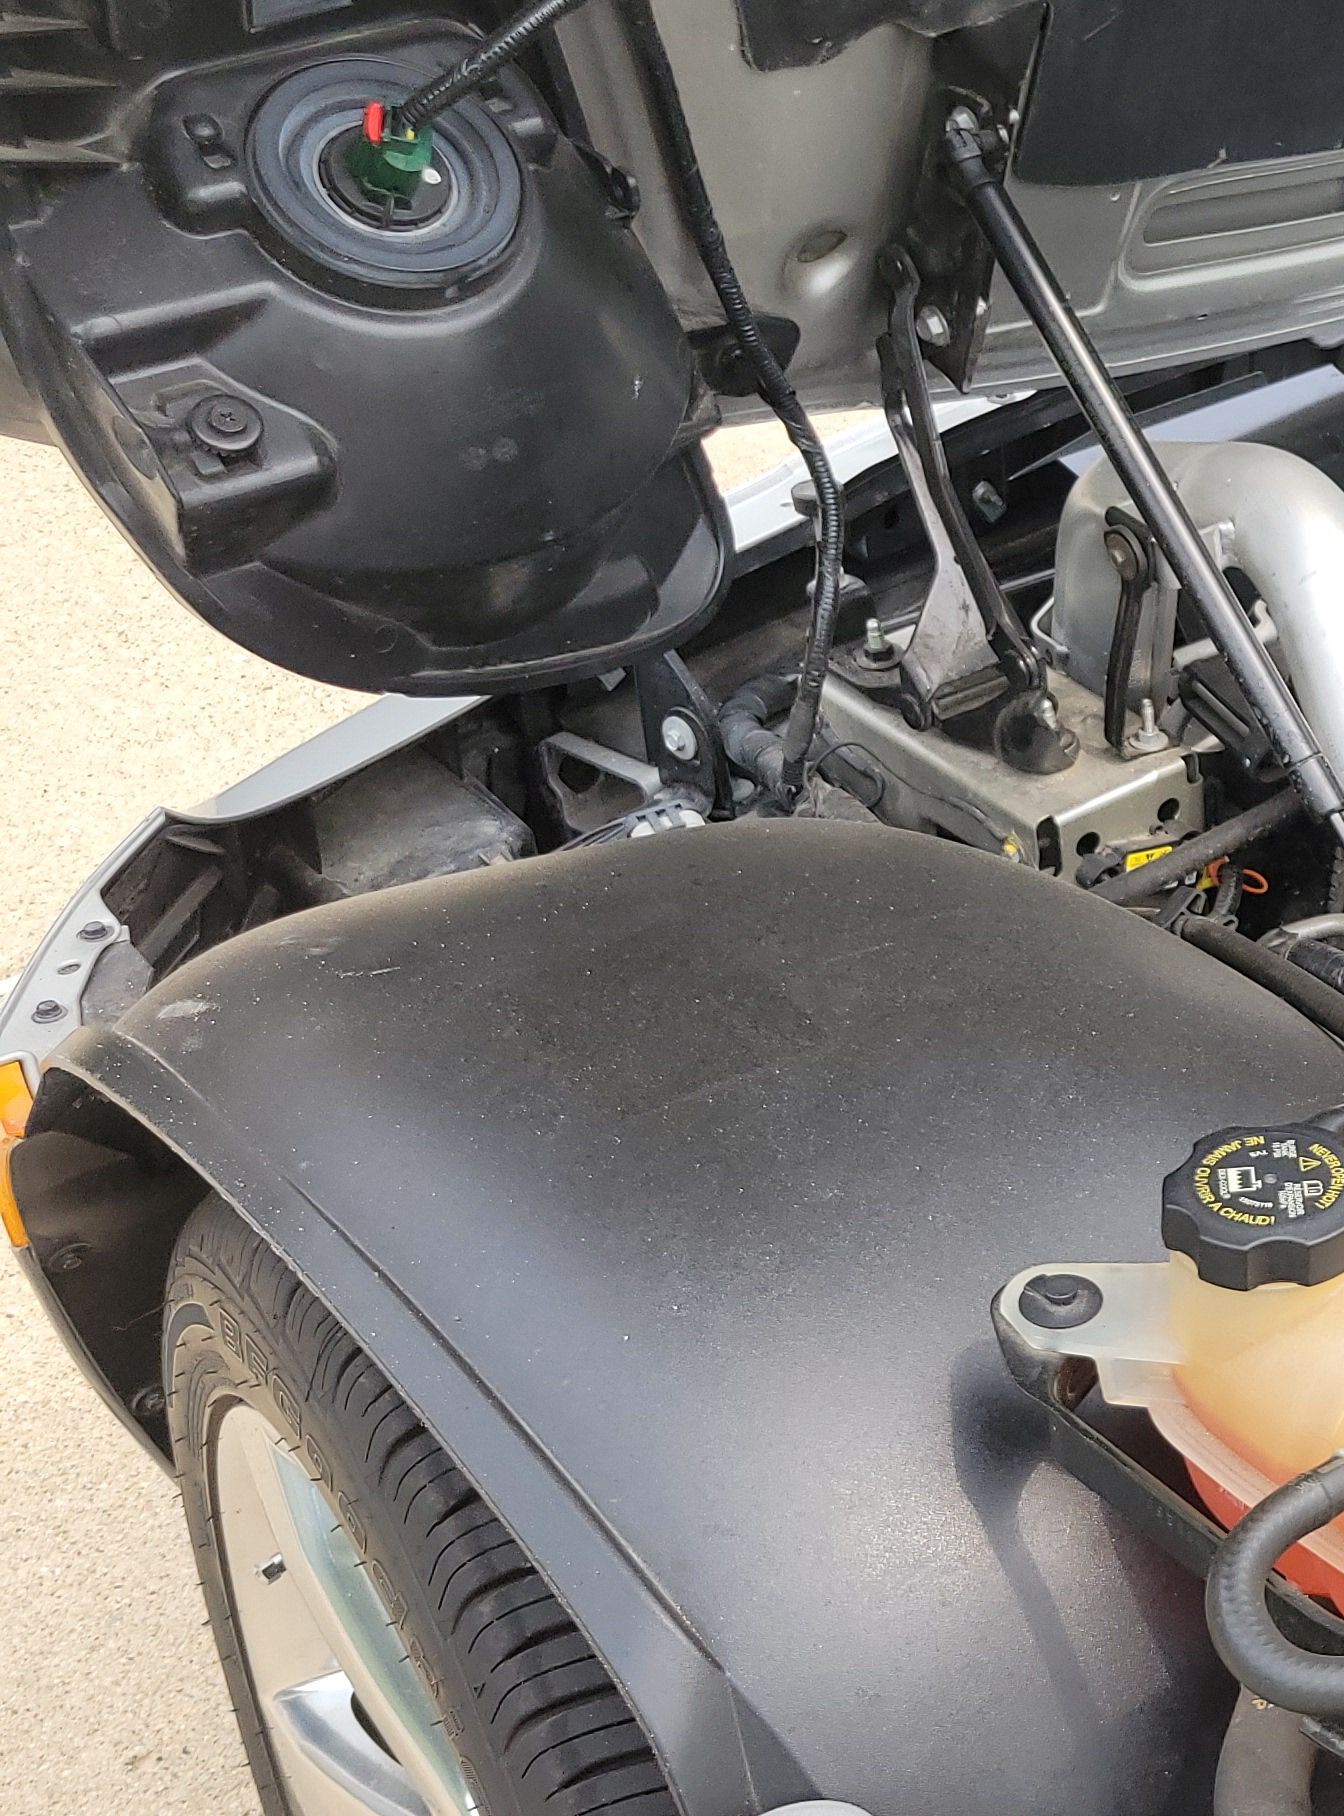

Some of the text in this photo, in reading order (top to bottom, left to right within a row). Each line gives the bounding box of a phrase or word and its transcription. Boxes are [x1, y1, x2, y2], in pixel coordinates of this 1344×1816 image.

[1202, 1139, 1241, 1165] JAMAIS
[1244, 1136, 1265, 1145] NE
[1309, 1143, 1341, 1168] NEVER
[1195, 1168, 1215, 1204] OUVRIR
[1220, 1207, 1275, 1226] CHAUD!
